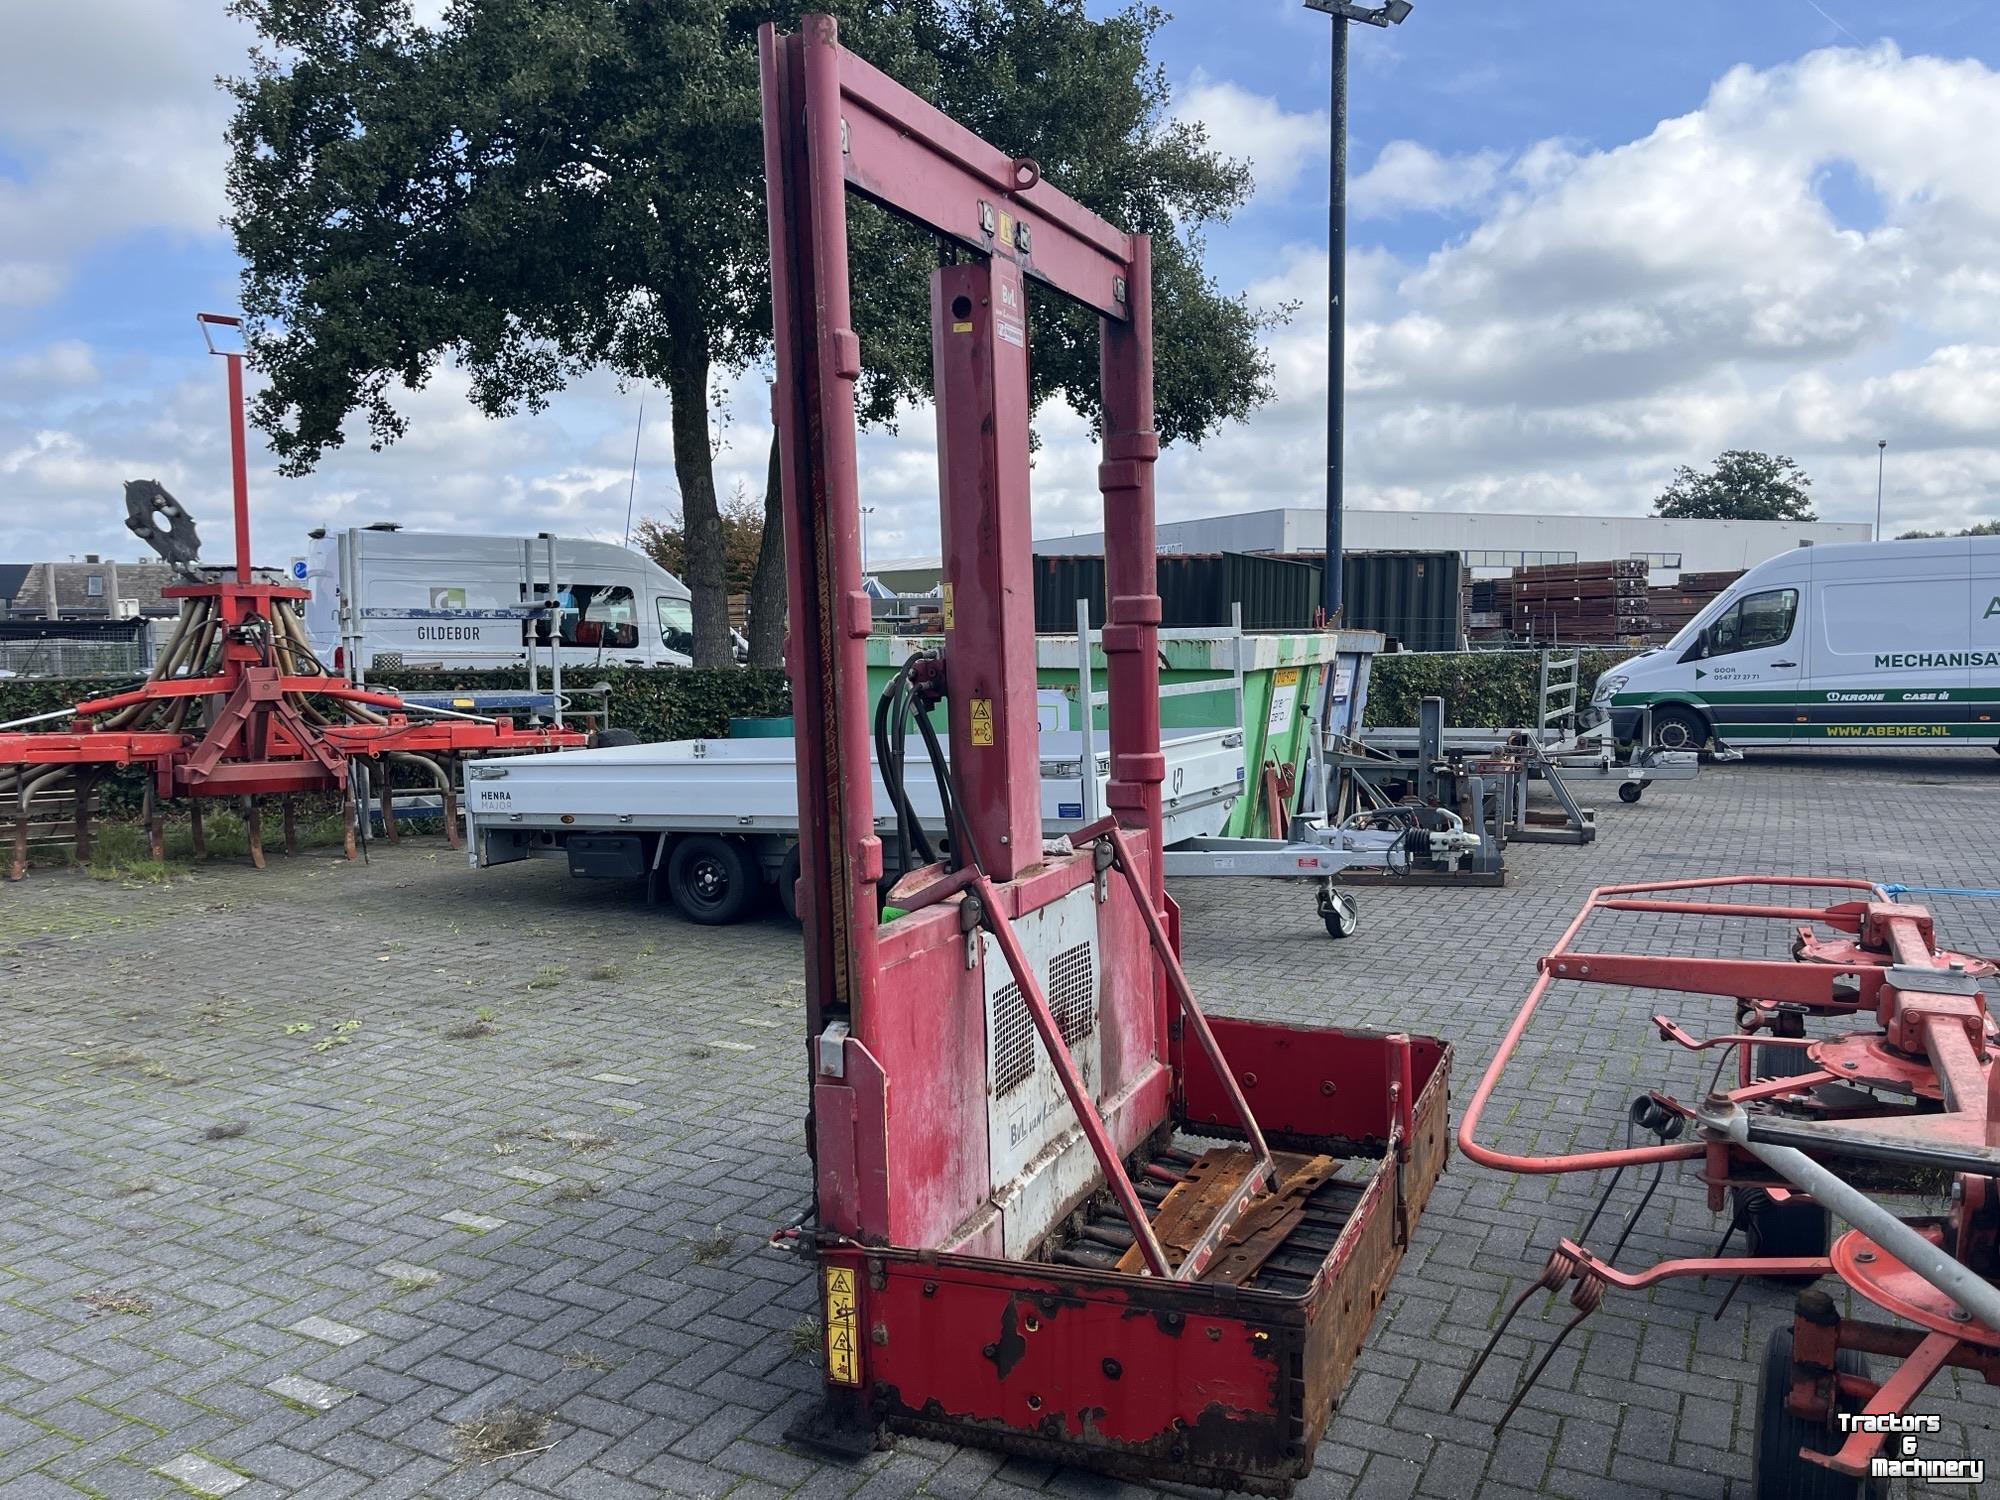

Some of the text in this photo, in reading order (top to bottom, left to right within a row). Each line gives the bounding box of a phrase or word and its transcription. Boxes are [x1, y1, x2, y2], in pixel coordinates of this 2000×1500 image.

[417, 626, 480, 640] GILDEBOR
[1874, 652, 2000, 668] MECHANISA
[1840, 693, 1885, 701] KRONE
[1902, 692, 1937, 701] CASE
[1826, 726, 1950, 737] WWW.ABEMEC.NL
[481, 791, 511, 800] HENRA
[481, 801, 512, 810] MAJOR
